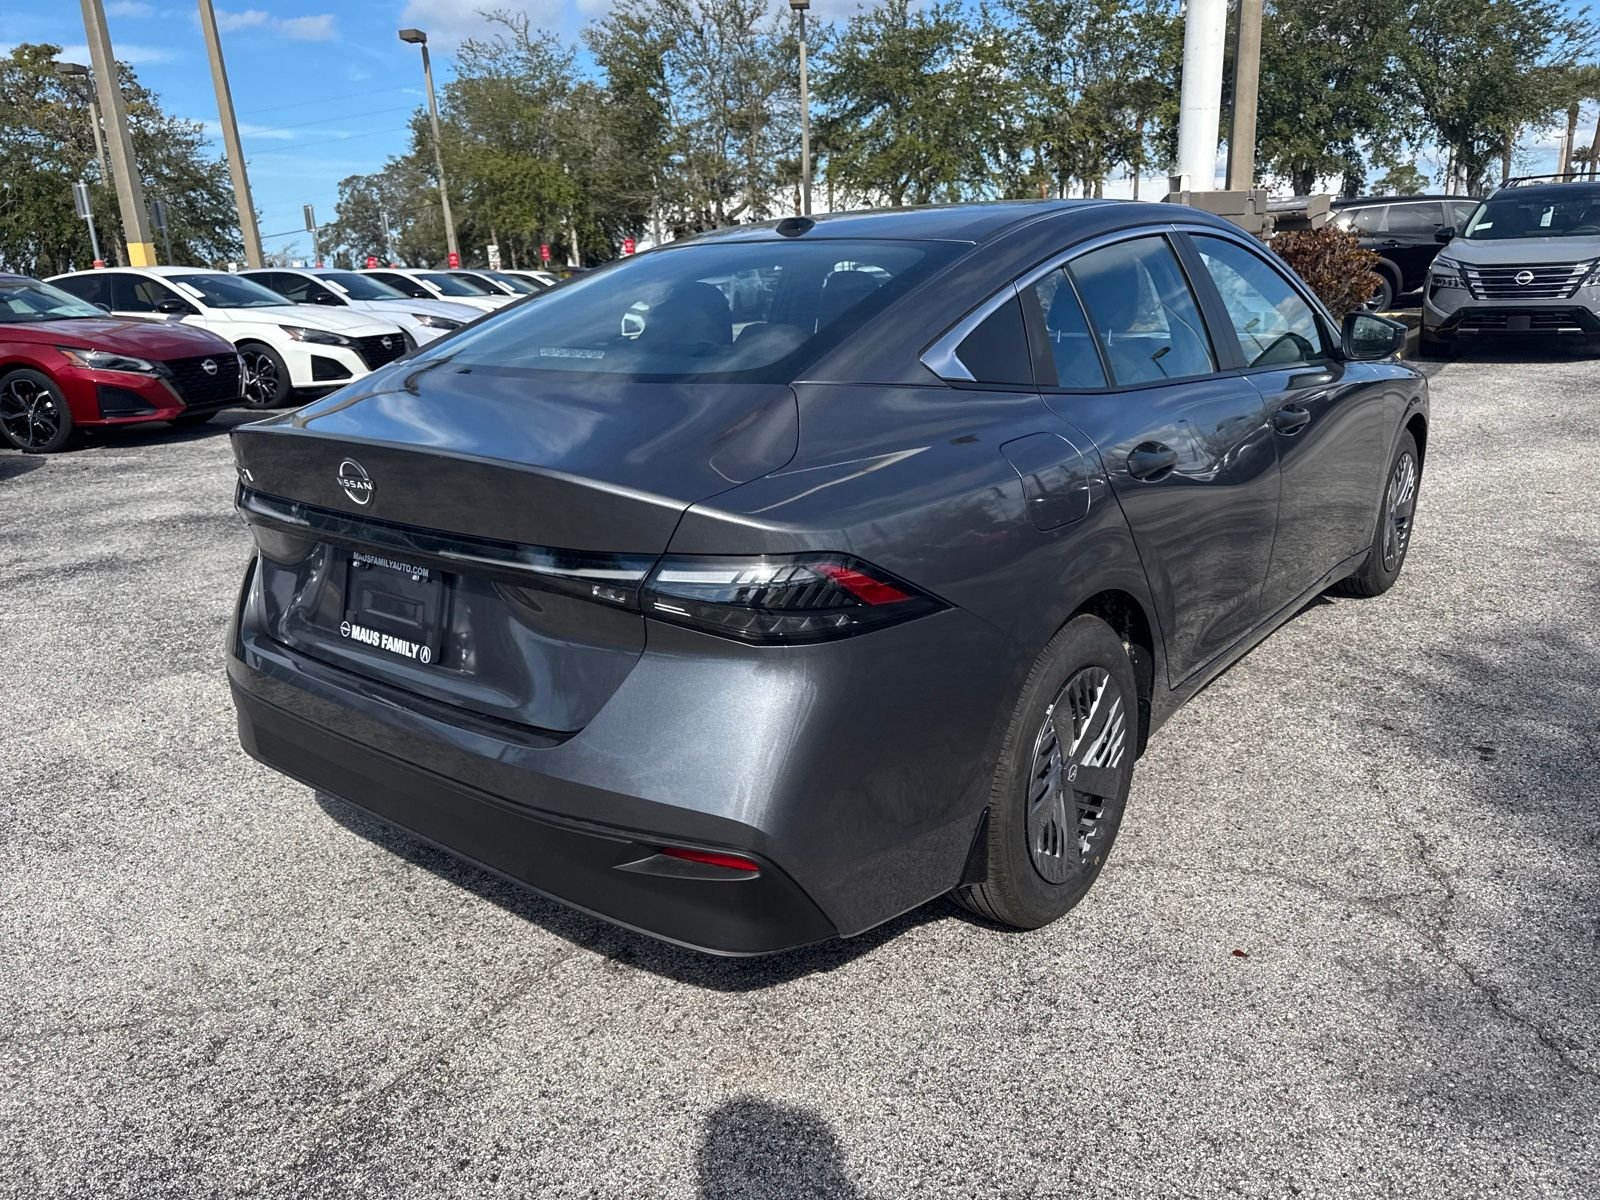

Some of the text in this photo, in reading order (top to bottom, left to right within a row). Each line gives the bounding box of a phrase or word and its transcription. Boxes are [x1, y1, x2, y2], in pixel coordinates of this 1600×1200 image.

[352, 551, 429, 577] MAUSFAMILYAUTO.COM
[351, 624, 420, 659] MAUS FAMILY
